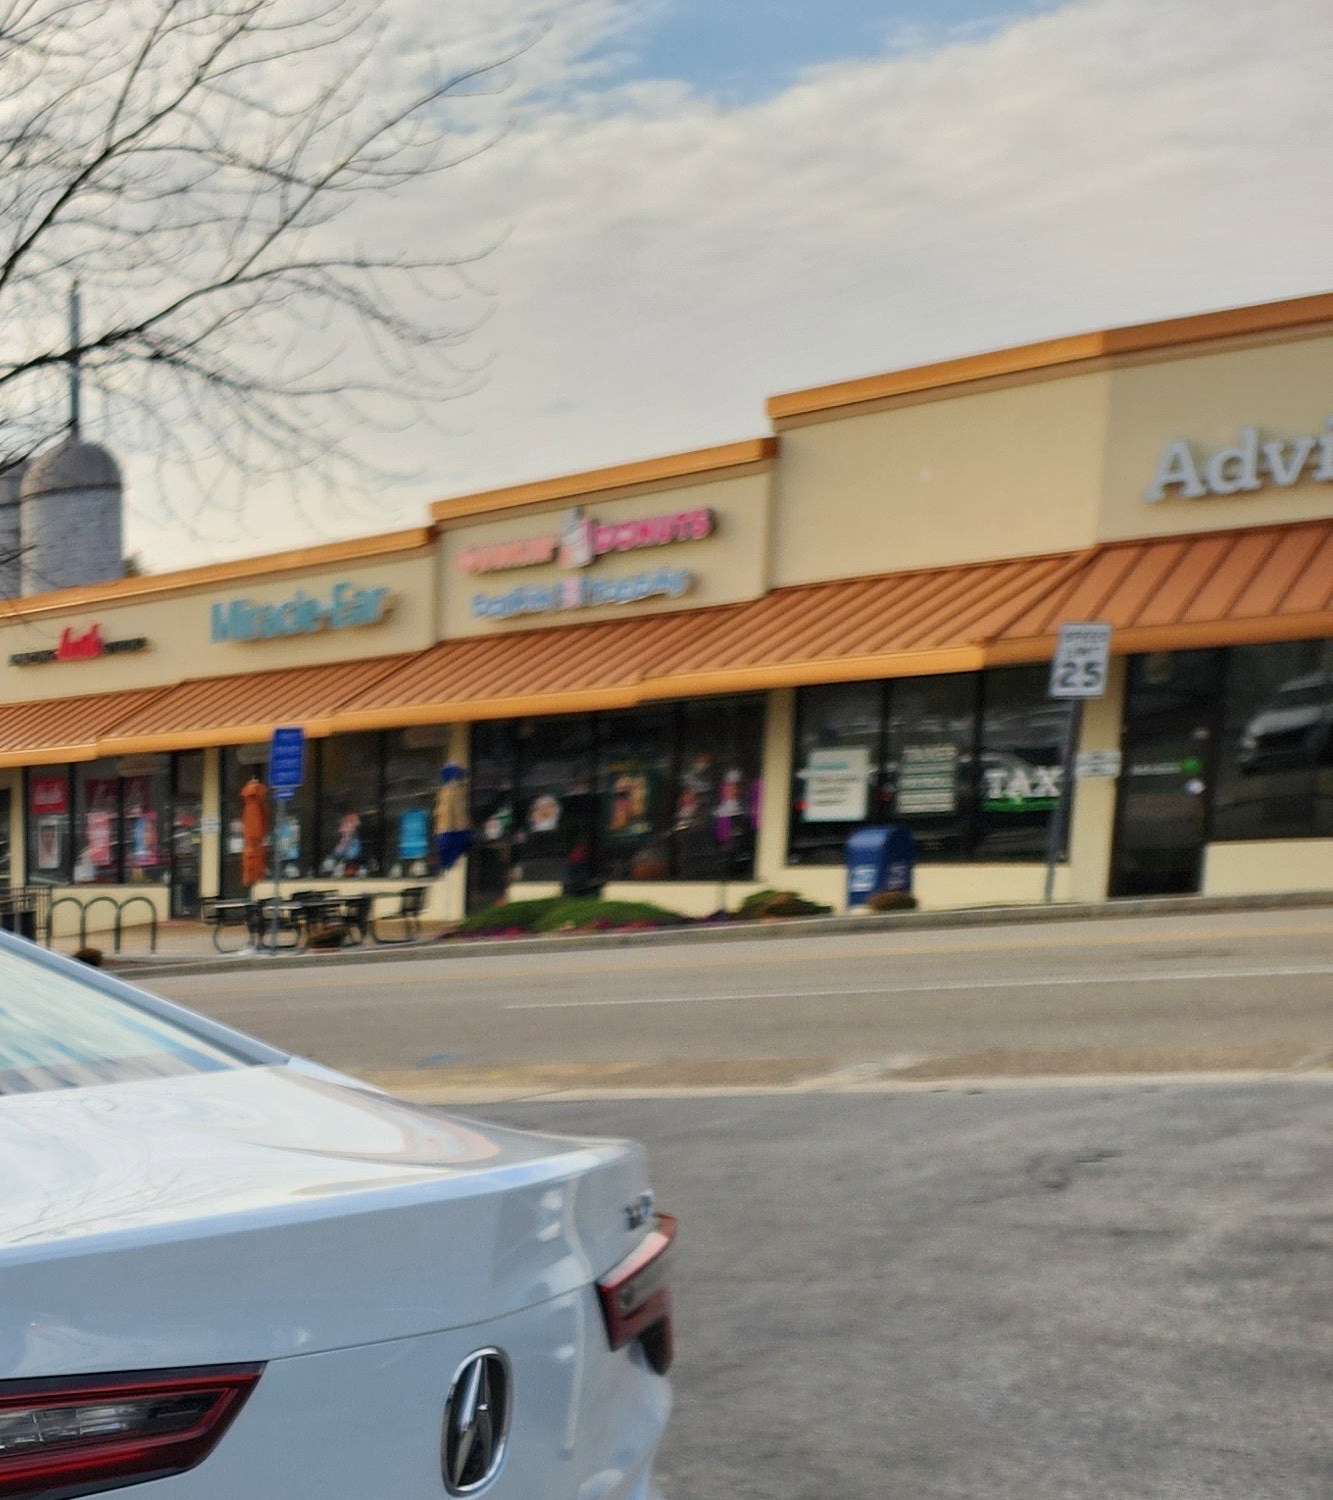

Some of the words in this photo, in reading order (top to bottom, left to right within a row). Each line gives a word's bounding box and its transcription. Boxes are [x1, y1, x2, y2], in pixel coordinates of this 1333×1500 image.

[1142, 413, 1333, 502] Advi
[211, 583, 389, 642] Miracle-Ear
[1059, 661, 1102, 689] 25
[985, 764, 1063, 799] TAX
